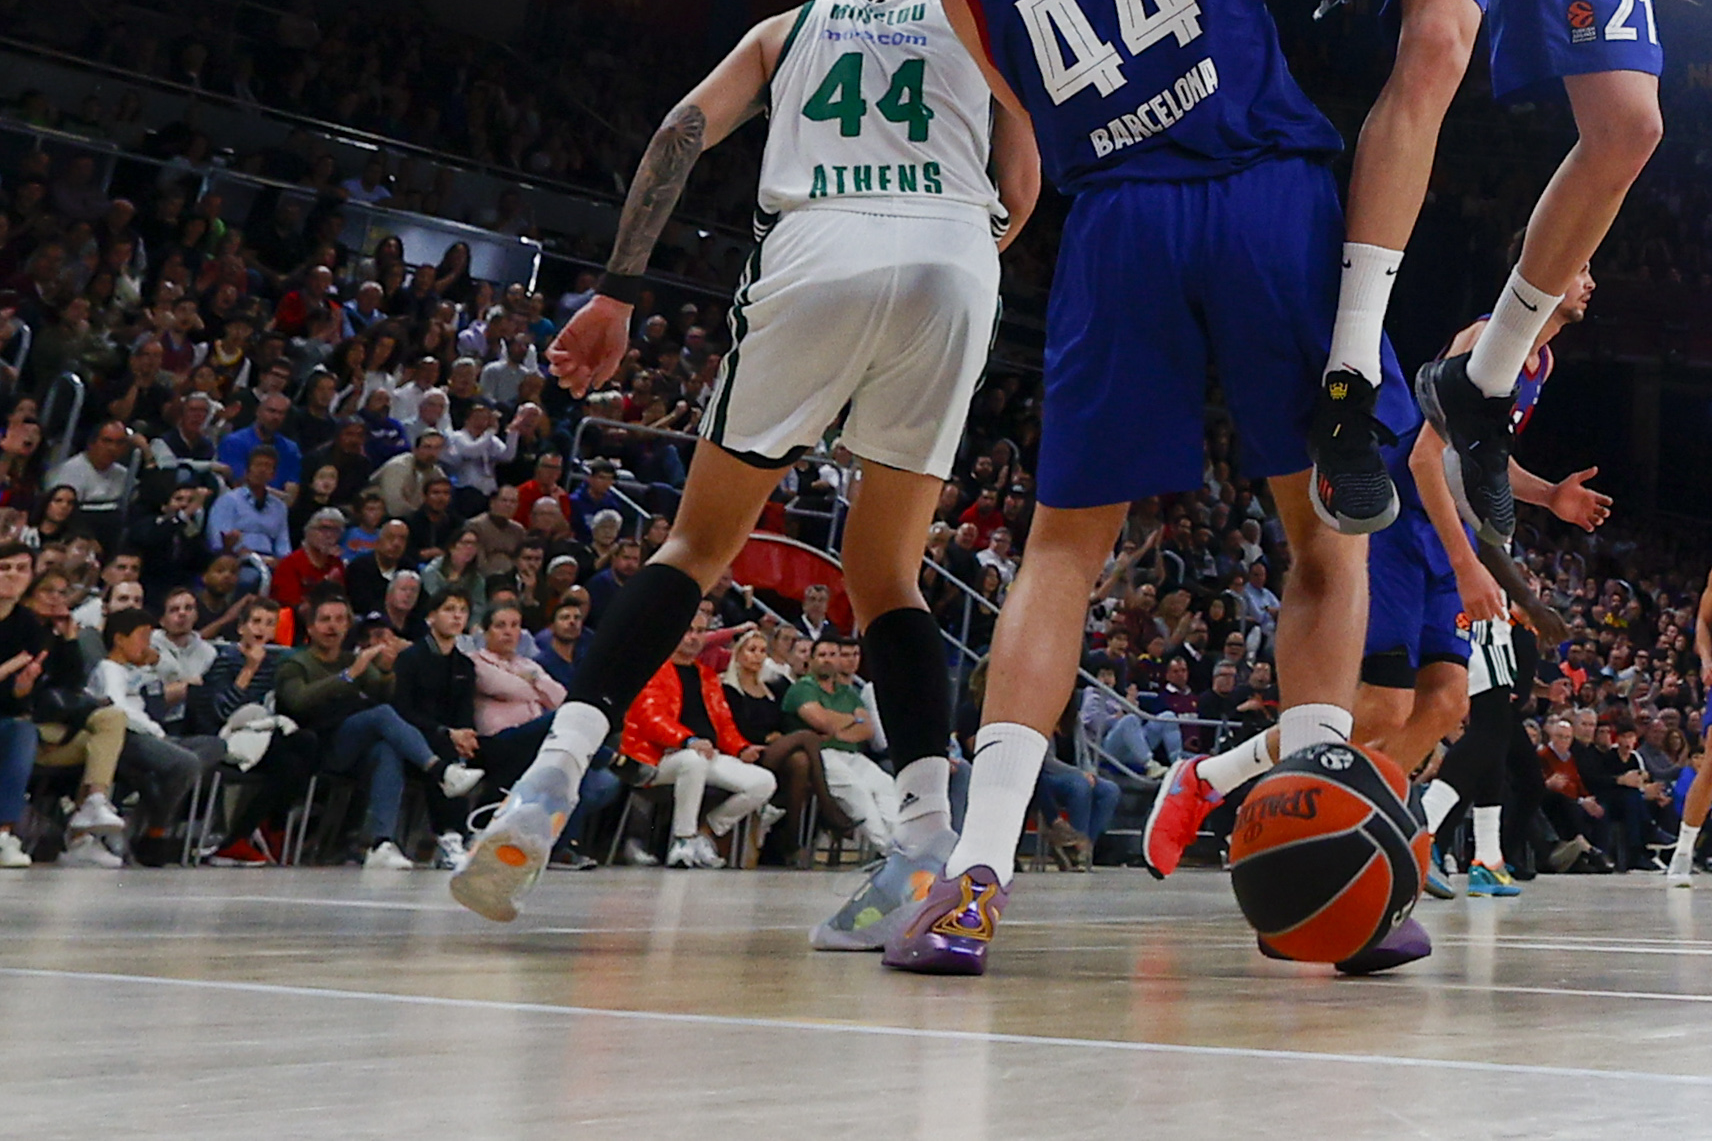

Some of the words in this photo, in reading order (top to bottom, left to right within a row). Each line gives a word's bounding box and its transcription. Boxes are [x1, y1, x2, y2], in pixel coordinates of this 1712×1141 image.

[802, 52, 934, 142] 44
[1089, 56, 1220, 159] BARCELONA
[809, 161, 943, 199] ATHENS
